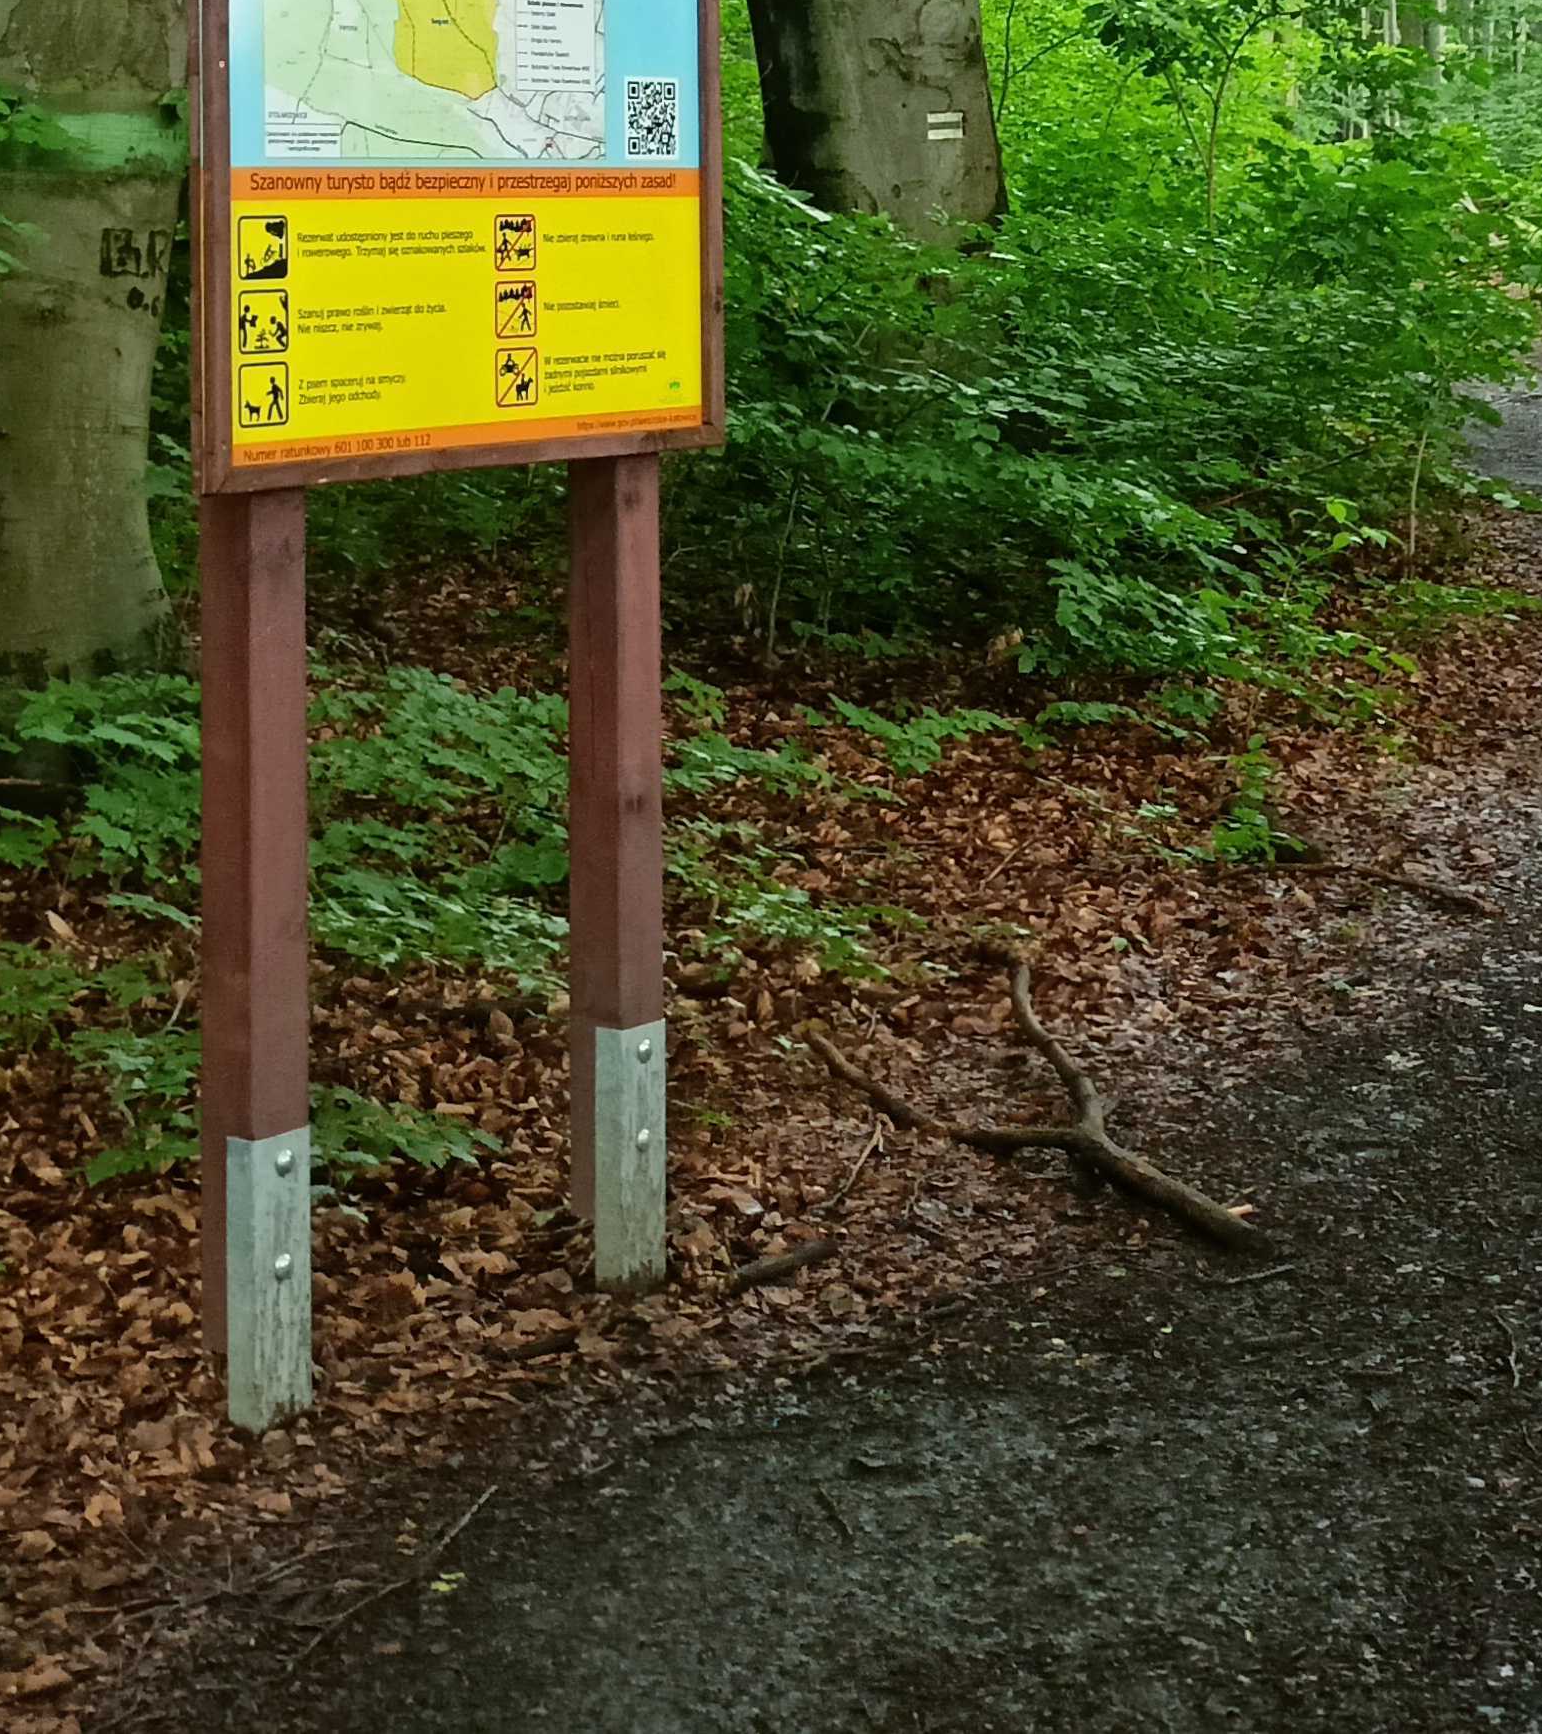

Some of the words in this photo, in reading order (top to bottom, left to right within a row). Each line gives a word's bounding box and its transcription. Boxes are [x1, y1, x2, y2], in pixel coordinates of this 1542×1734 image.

[250, 172, 322, 194] Szanowny
[327, 173, 375, 194] turysto
[379, 172, 412, 194] bądź
[415, 173, 485, 193] bezpieczny
[497, 173, 571, 193] przestrzegaj
[575, 172, 637, 192] poniższych
[640, 172, 676, 189] zasad!
[243, 448, 277, 463] Numer
[280, 444, 332, 460] ratunkowy
[334, 441, 352, 454] 601
[355, 438, 374, 452] 100
[376, 436, 394, 450] 300
[414, 433, 431, 447] 112
